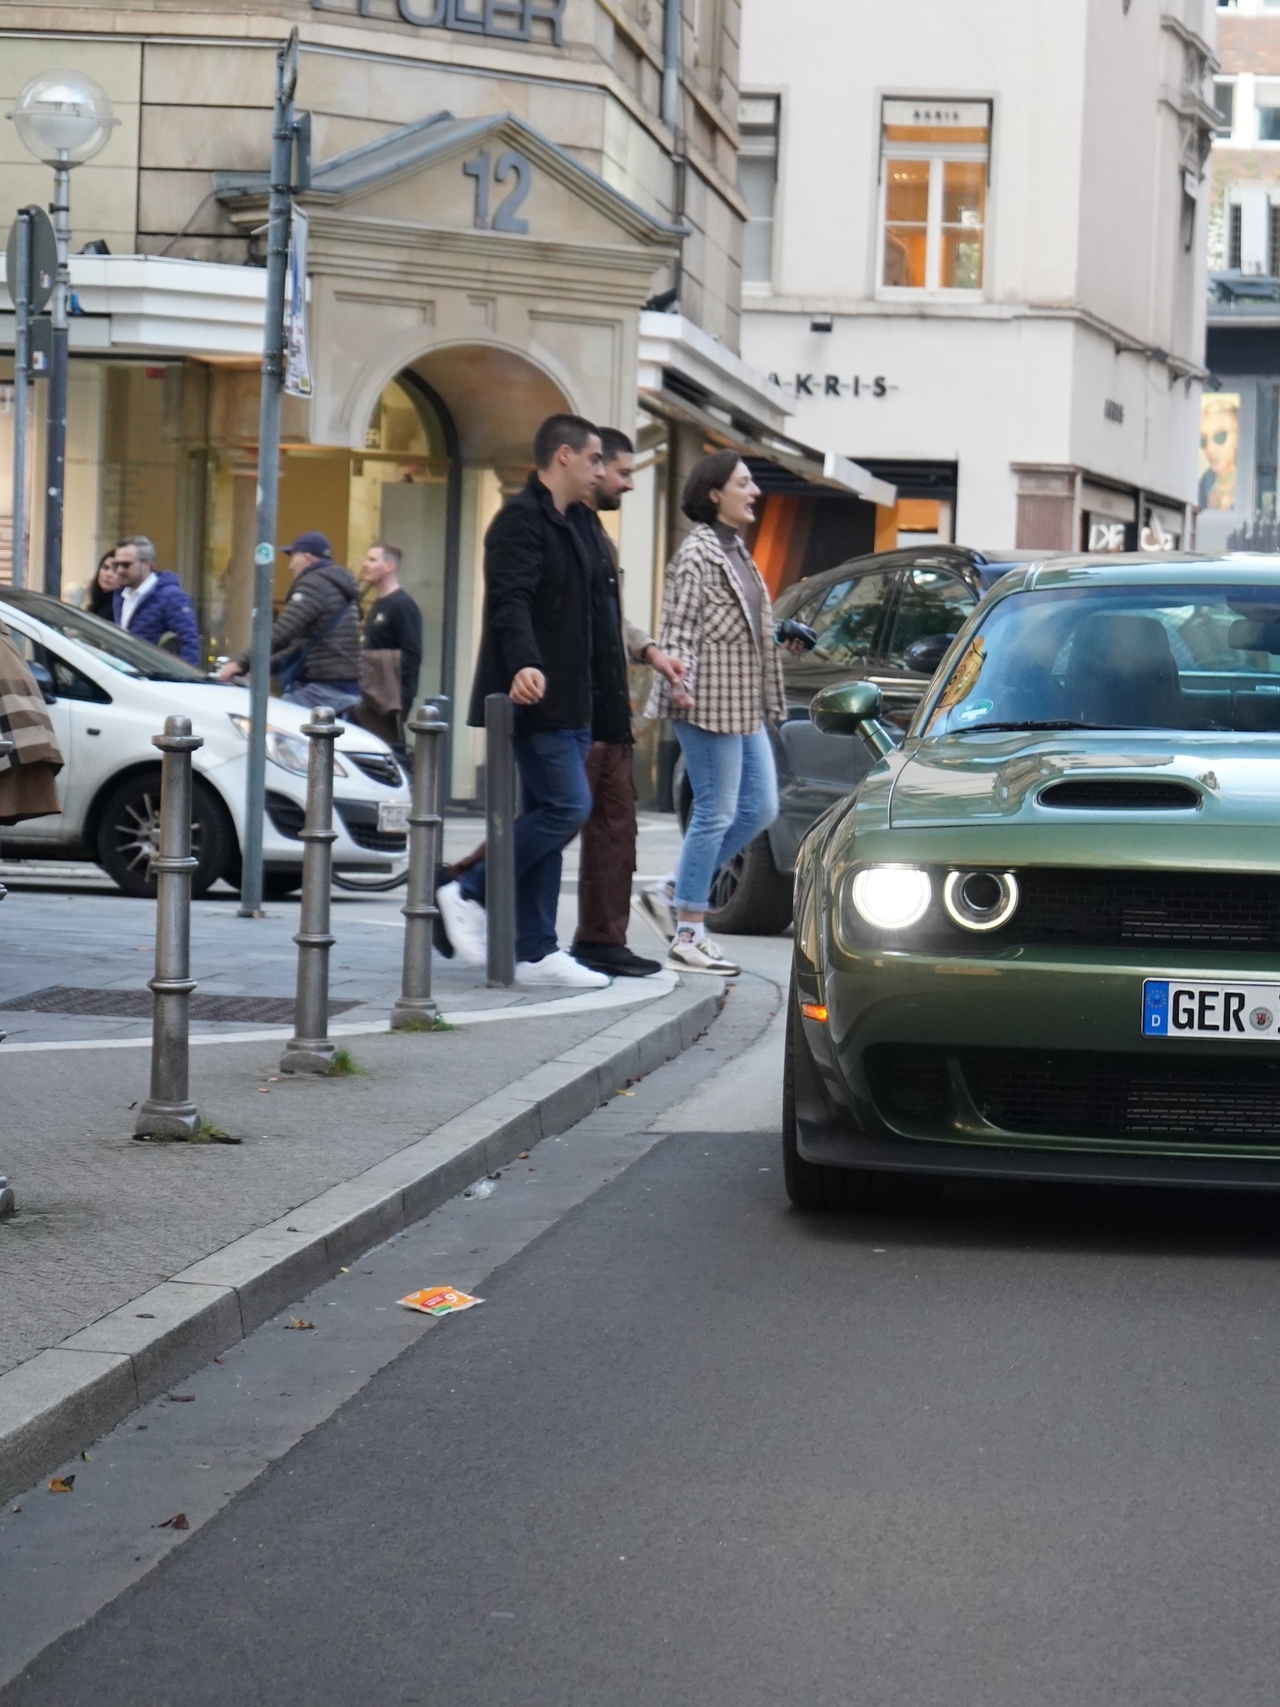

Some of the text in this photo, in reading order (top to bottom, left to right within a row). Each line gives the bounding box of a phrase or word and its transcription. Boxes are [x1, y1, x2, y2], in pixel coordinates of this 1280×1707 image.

[462, 148, 532, 234] 12
[1151, 1015, 1161, 1027] D
[1172, 989, 1245, 1032] GER
